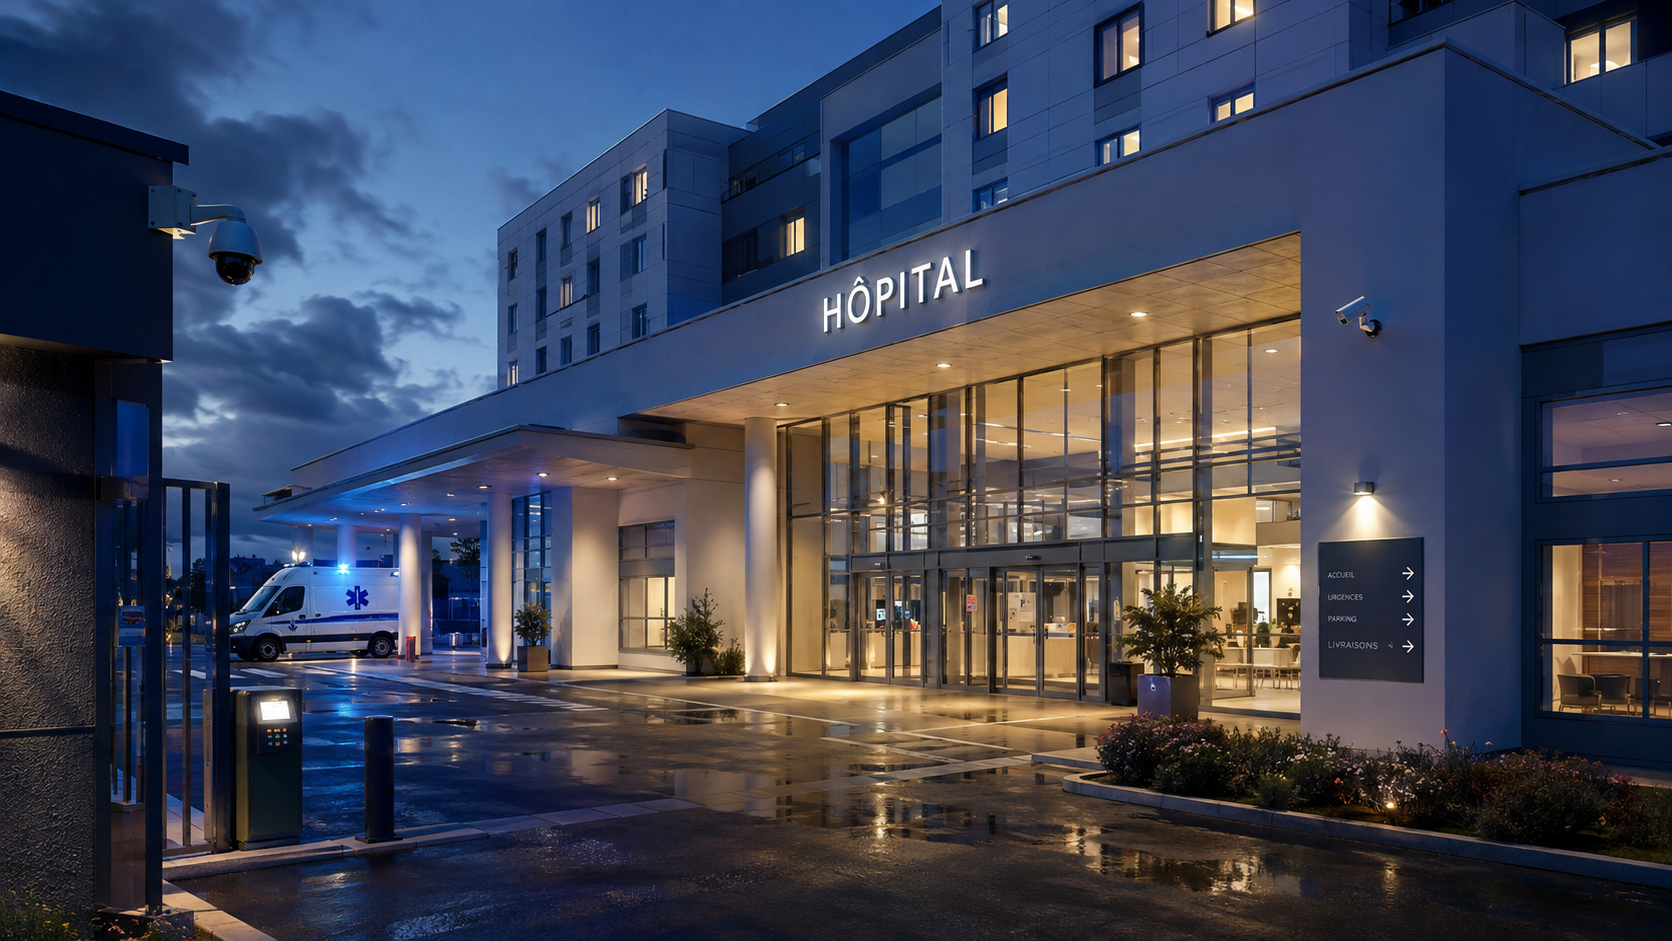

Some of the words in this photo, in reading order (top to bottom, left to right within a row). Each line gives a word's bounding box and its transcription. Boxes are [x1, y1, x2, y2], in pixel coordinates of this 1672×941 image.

[823, 249, 985, 333] HÔPITAL
[1327, 571, 1355, 579] ACCUEIL
[1327, 593, 1364, 601] URGENCES
[1327, 615, 1357, 623] PARKING
[1327, 641, 1379, 650] LIVRAISONS
